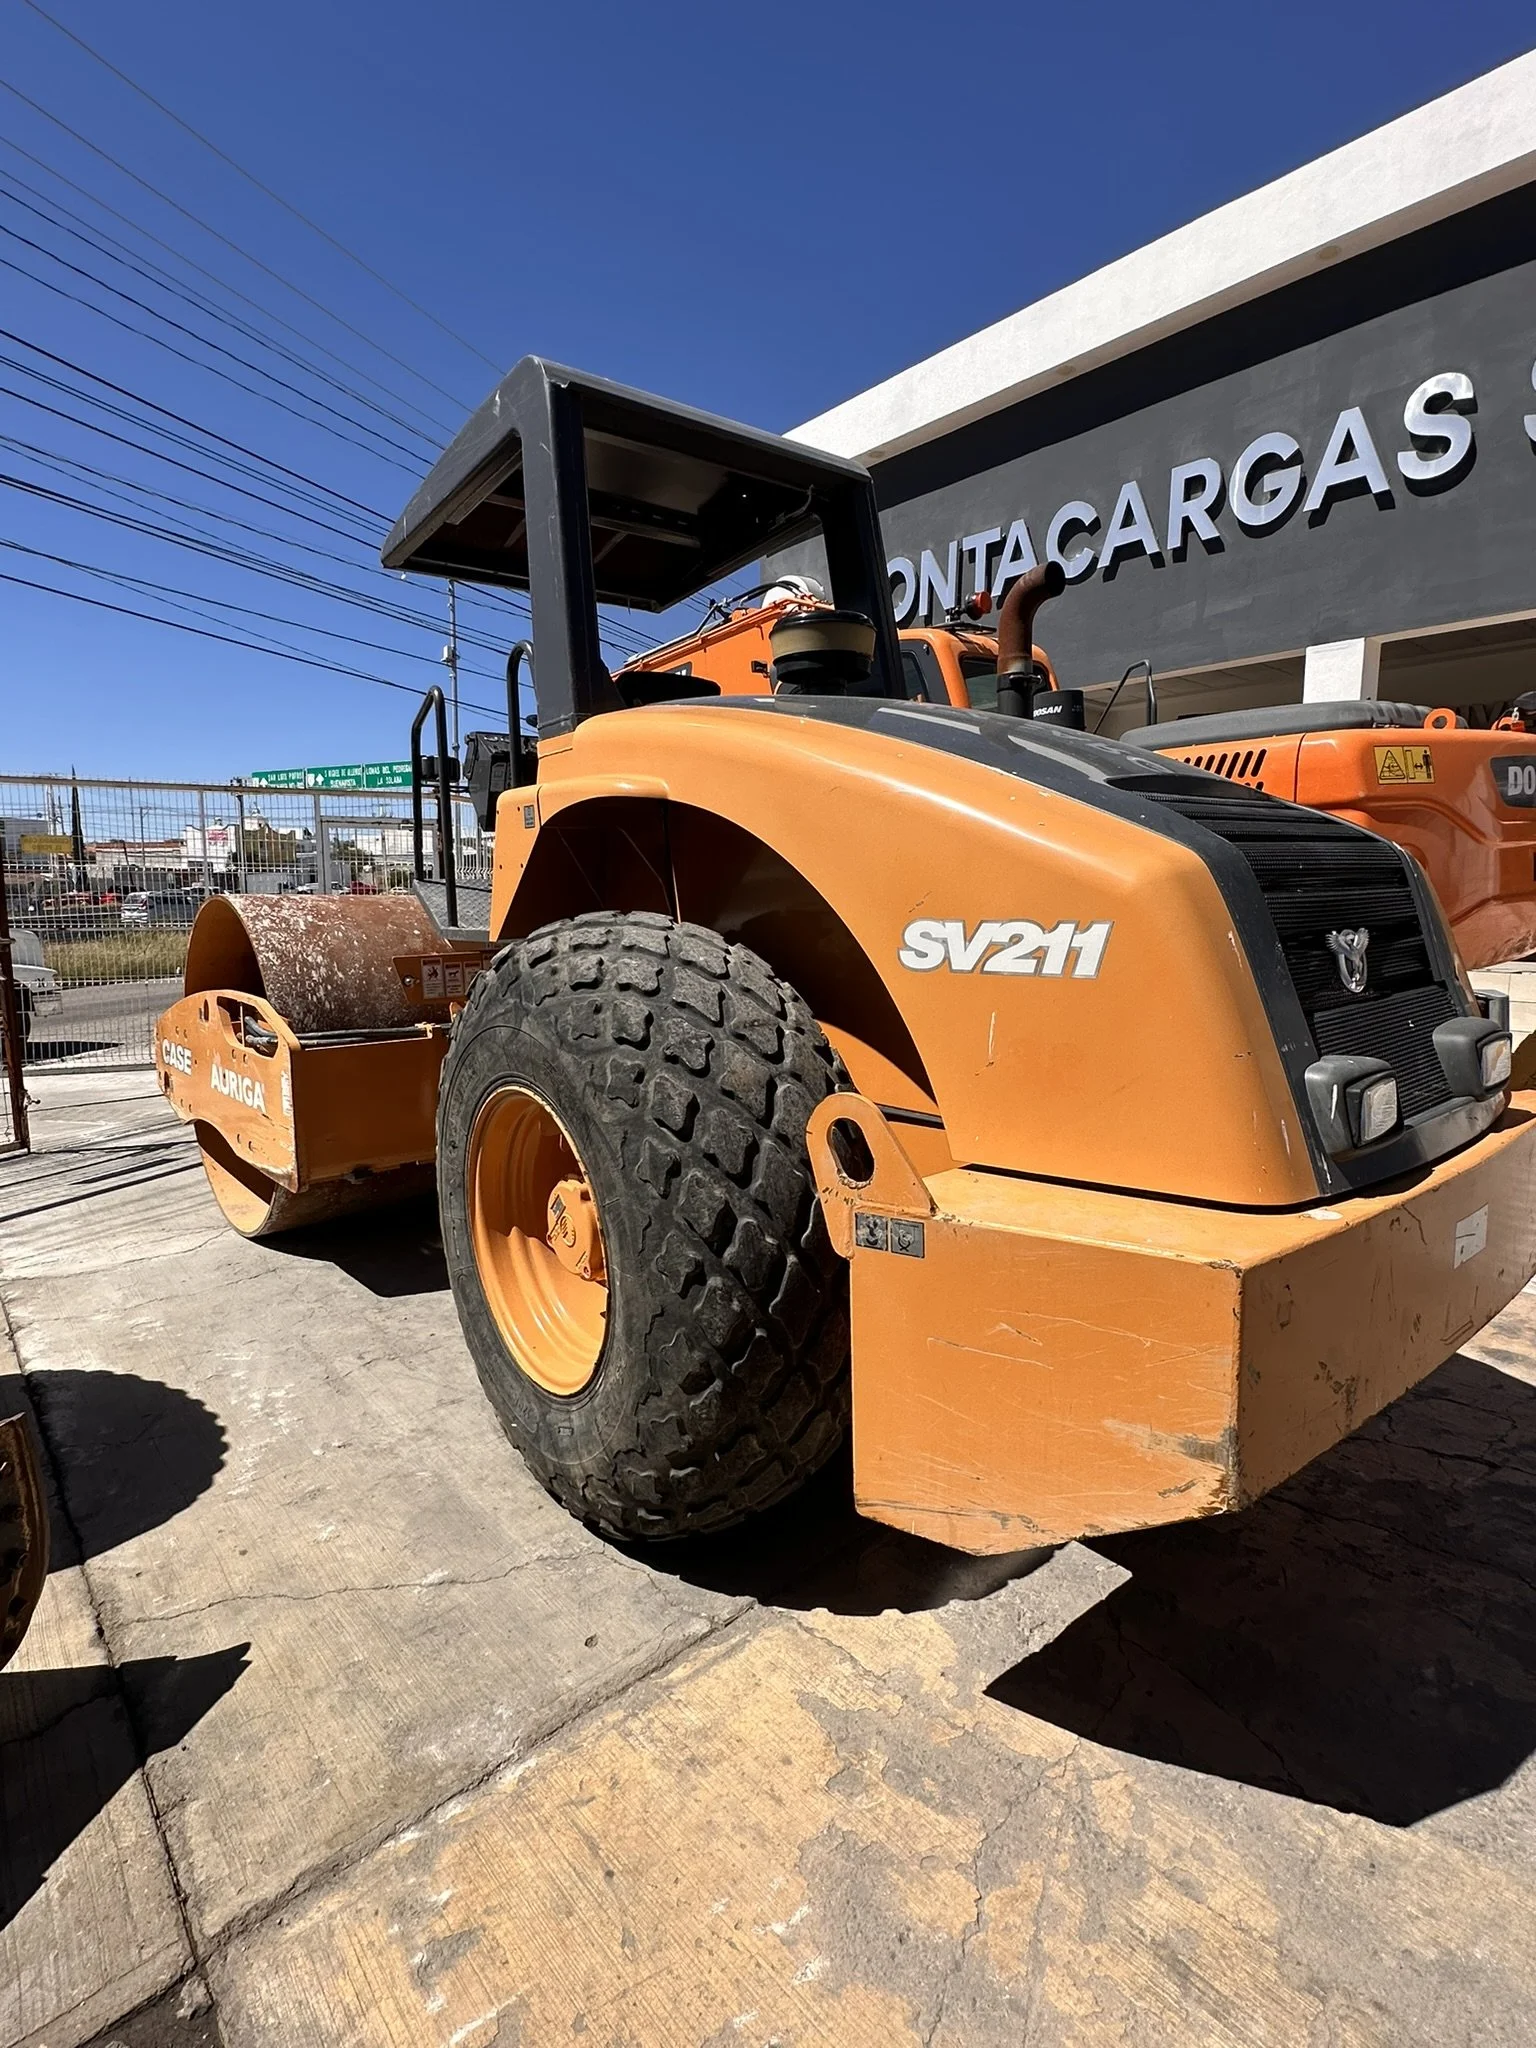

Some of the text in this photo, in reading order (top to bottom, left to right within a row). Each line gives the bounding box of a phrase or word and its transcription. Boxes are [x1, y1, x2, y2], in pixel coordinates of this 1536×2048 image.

[1507, 765, 1536, 796] DO
[898, 918, 1115, 979] SV211
[162, 1039, 192, 1076] CASE
[210, 1063, 267, 1114] AURIGA
